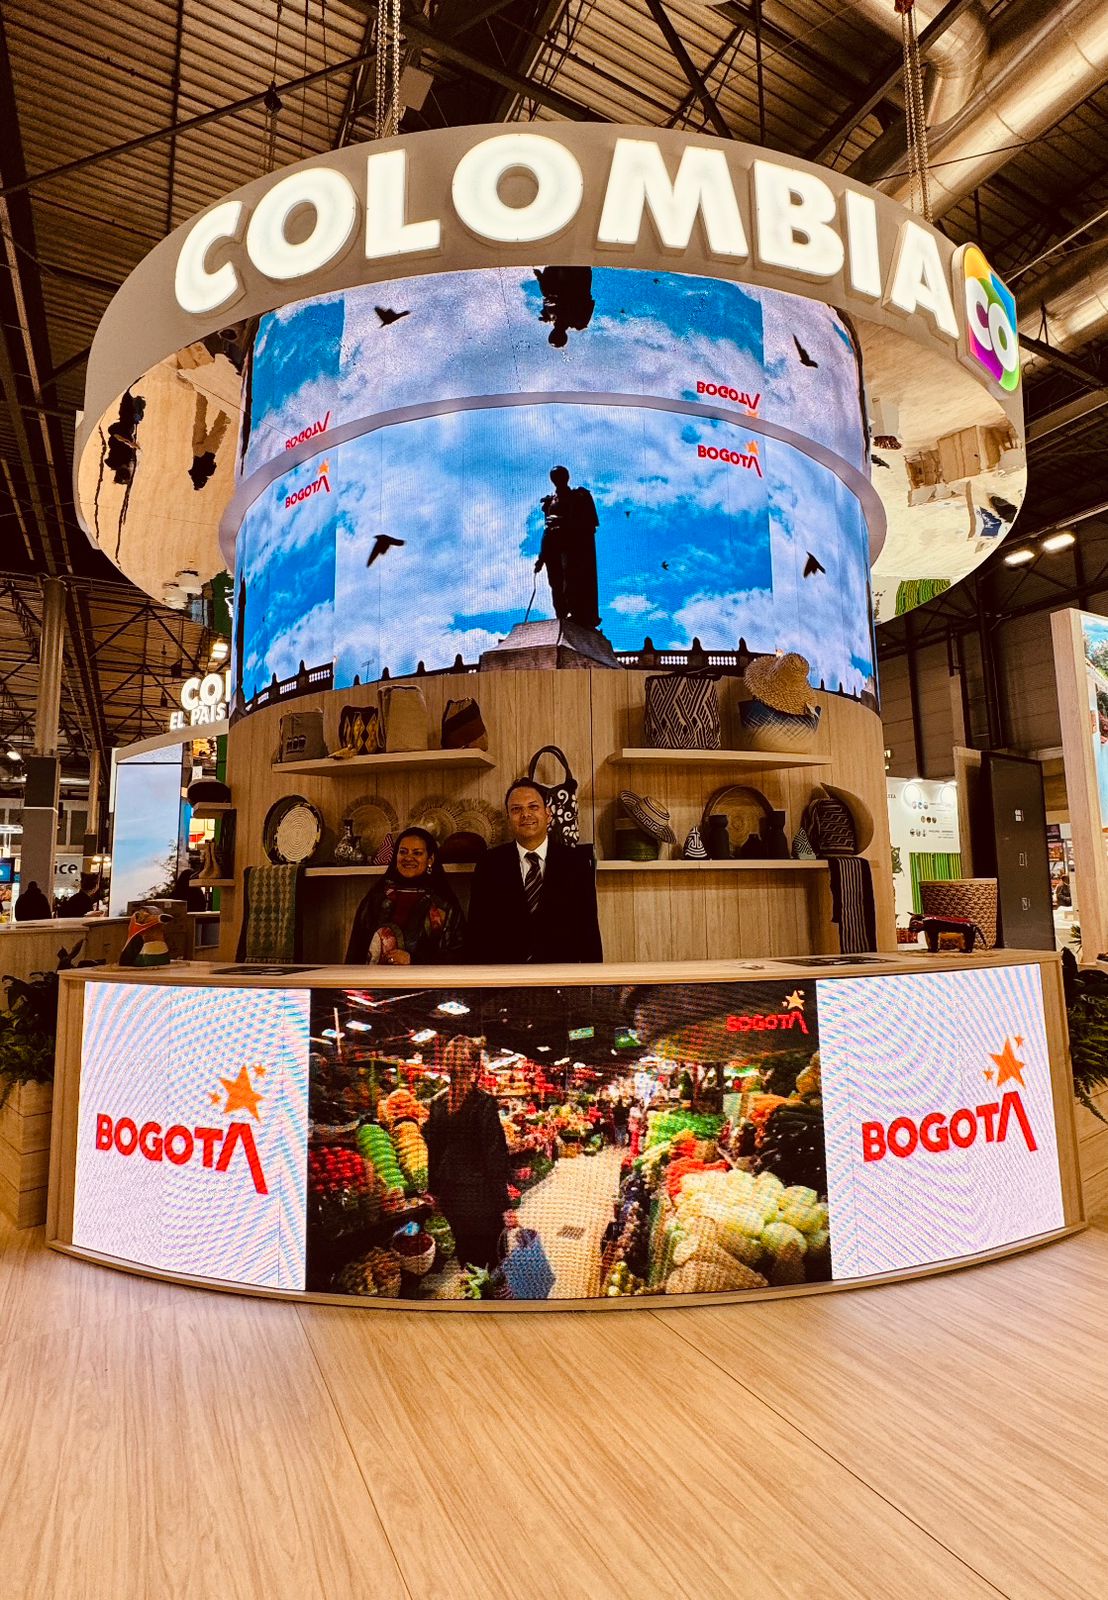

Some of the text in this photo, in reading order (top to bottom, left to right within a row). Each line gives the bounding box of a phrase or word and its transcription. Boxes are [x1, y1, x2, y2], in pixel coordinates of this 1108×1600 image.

[174, 133, 960, 341] COLOMBIA
[965, 276, 1018, 372] CO
[170, 711, 185, 730] EL
